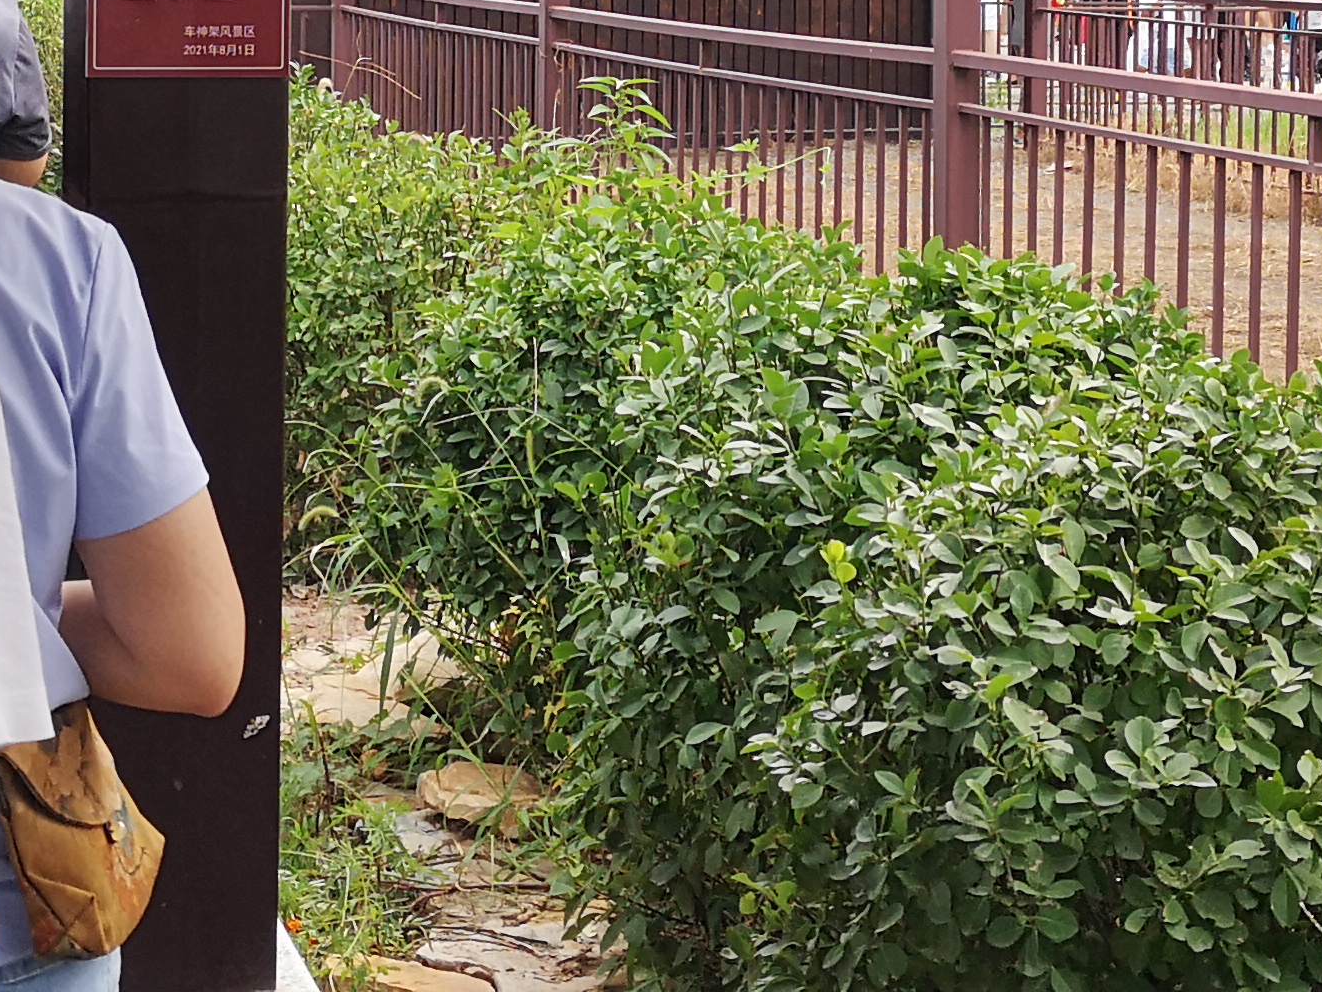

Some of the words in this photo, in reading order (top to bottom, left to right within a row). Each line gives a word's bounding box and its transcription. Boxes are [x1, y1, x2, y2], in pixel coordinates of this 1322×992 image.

[183, 25, 256, 39] 车神架风景区
[182, 43, 255, 57] 2021年8月1日
